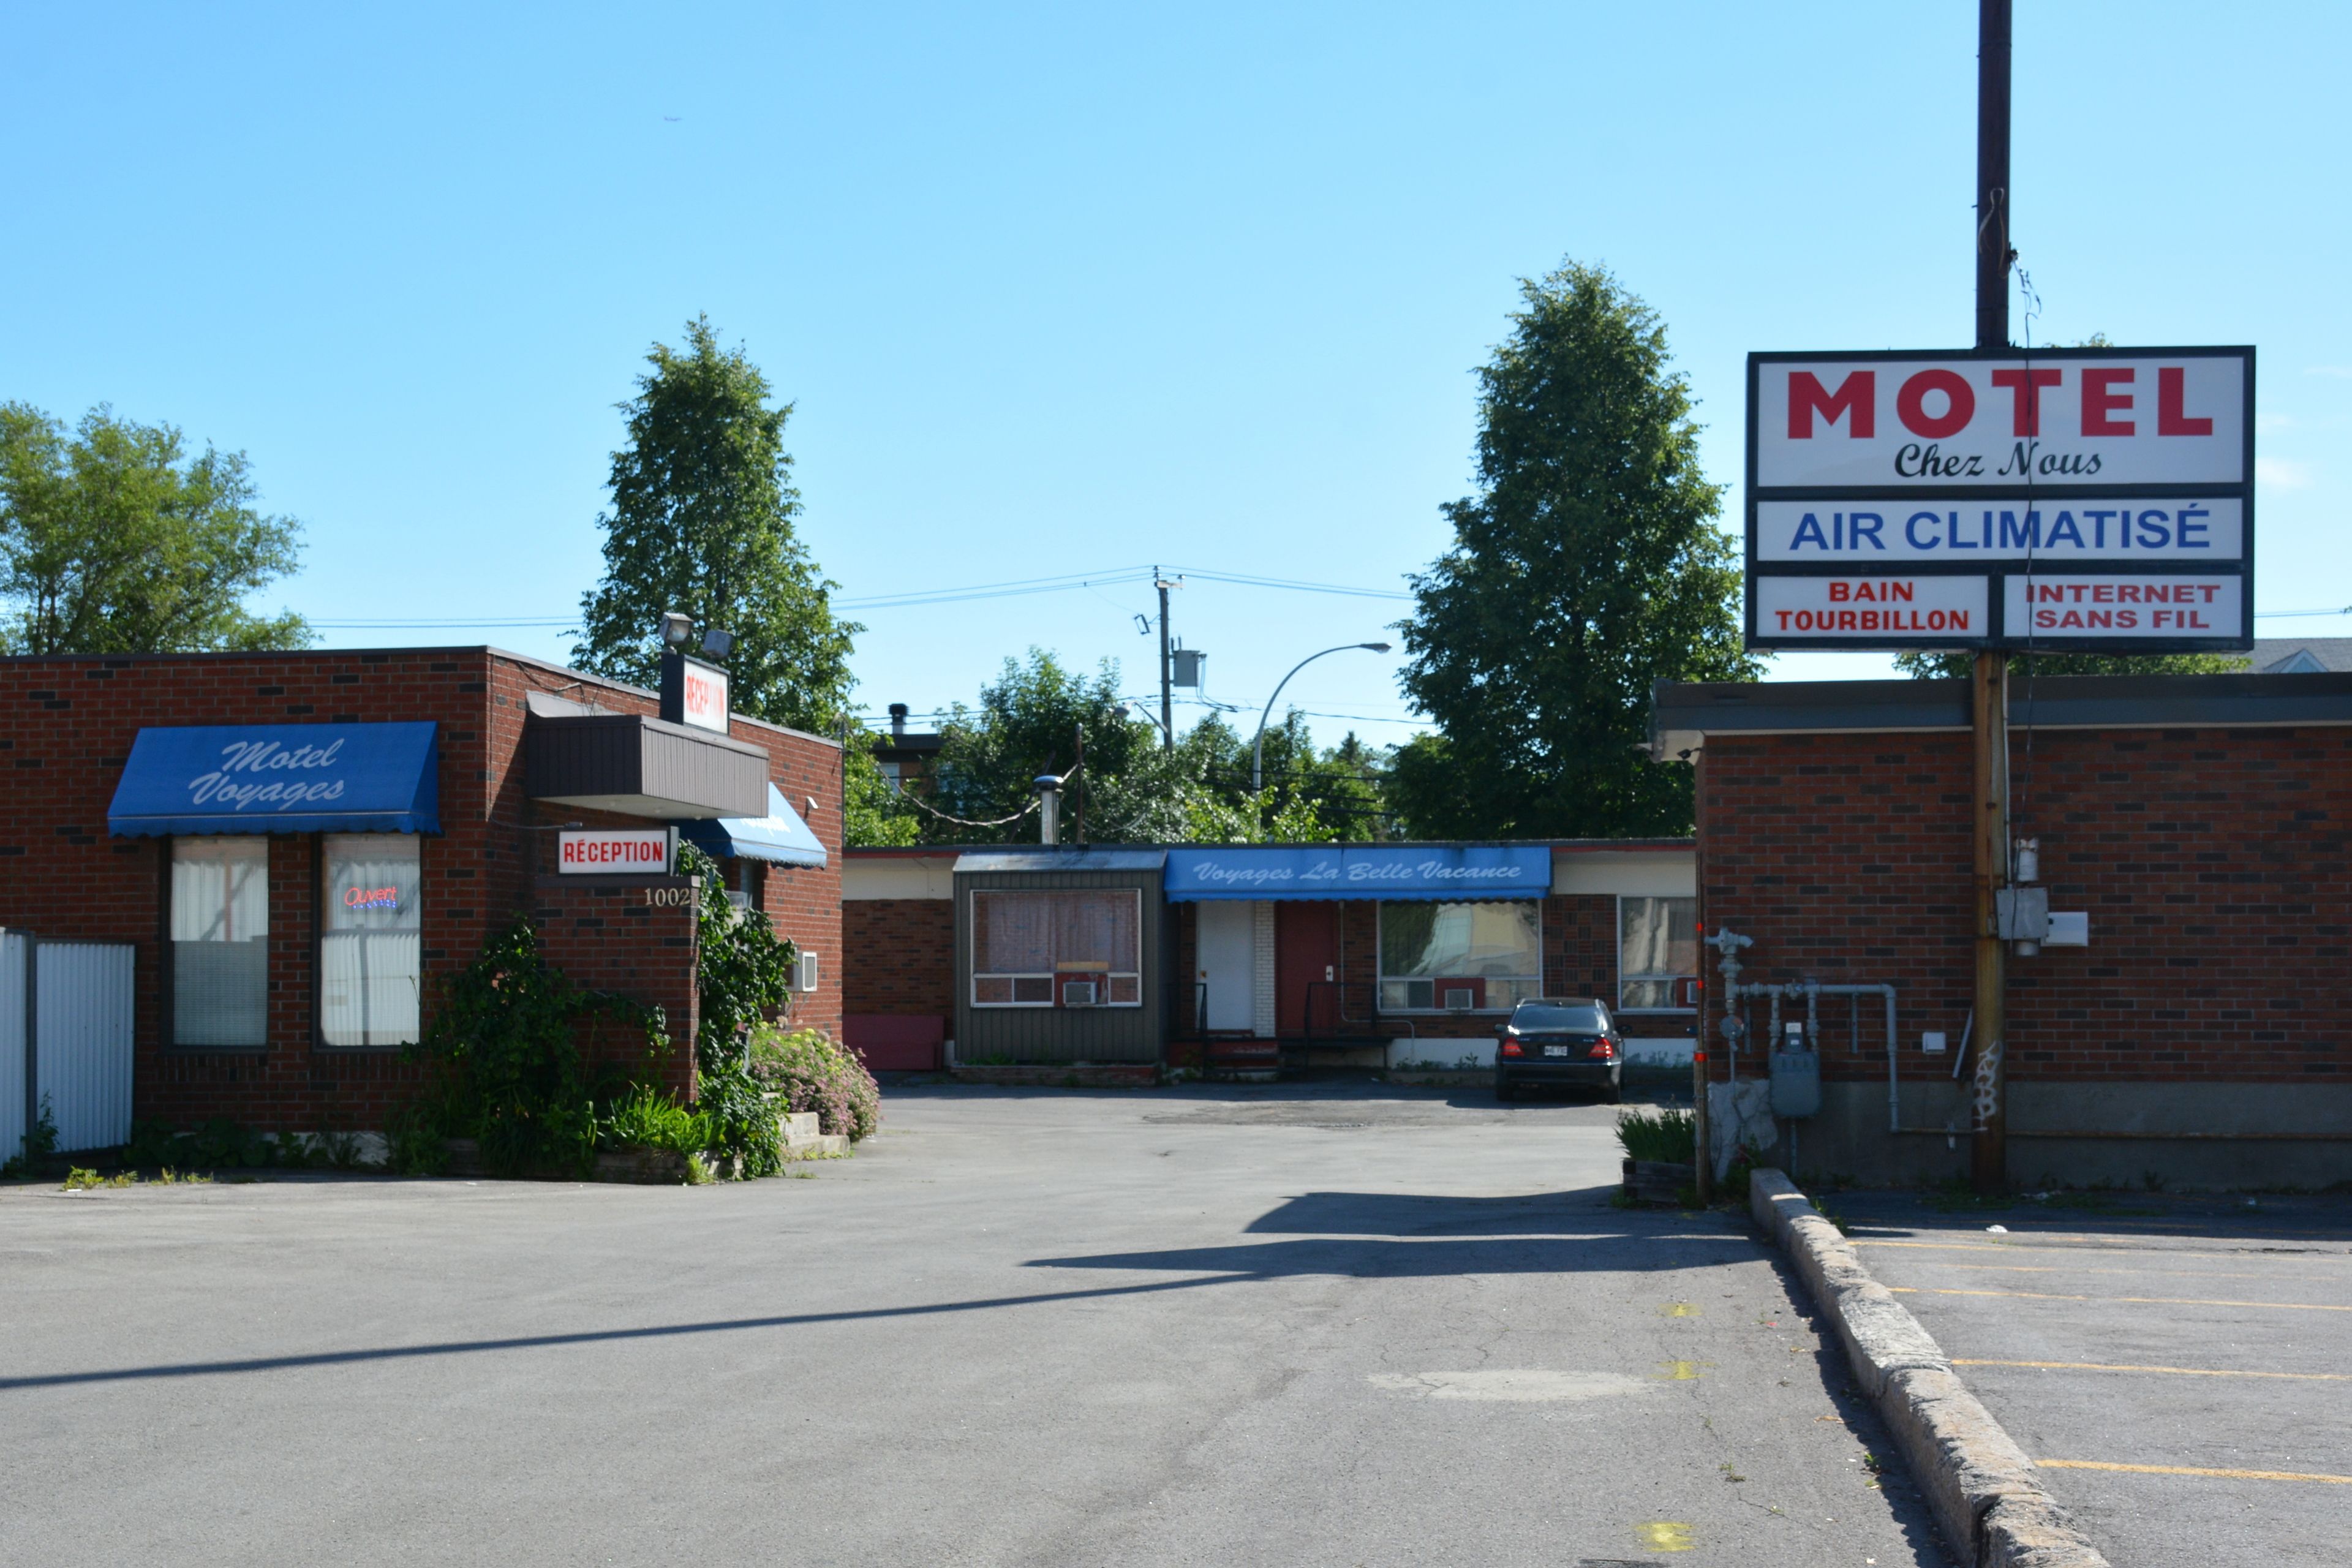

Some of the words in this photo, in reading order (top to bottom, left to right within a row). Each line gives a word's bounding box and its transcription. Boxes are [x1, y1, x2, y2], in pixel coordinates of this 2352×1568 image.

[1788, 368, 2214, 439] MOTEL
[1894, 443, 1985, 477] Chez
[1997, 440, 2102, 476] Nous
[1789, 512, 1887, 551] AIR
[1905, 503, 2210, 549] CLIMATISÉ
[1829, 582, 1913, 602] BAIN
[2026, 584, 2220, 603] INTERNET
[1776, 610, 1969, 631] TOURBILLON
[2035, 609, 2138, 629] SANS
[2154, 609, 2209, 629] FIL
[687, 673, 724, 717] RÉCEPON
[221, 738, 344, 772] Motel
[188, 772, 344, 810] Voyages
[564, 839, 663, 863] RÉCEPTION
[1193, 862, 1294, 885] Voyages
[1299, 861, 1341, 880] La
[1348, 862, 1413, 881] Belle
[1417, 861, 1521, 879] Vacance
[345, 886, 397, 906] Ouvert
[645, 888, 691, 907] 1002
